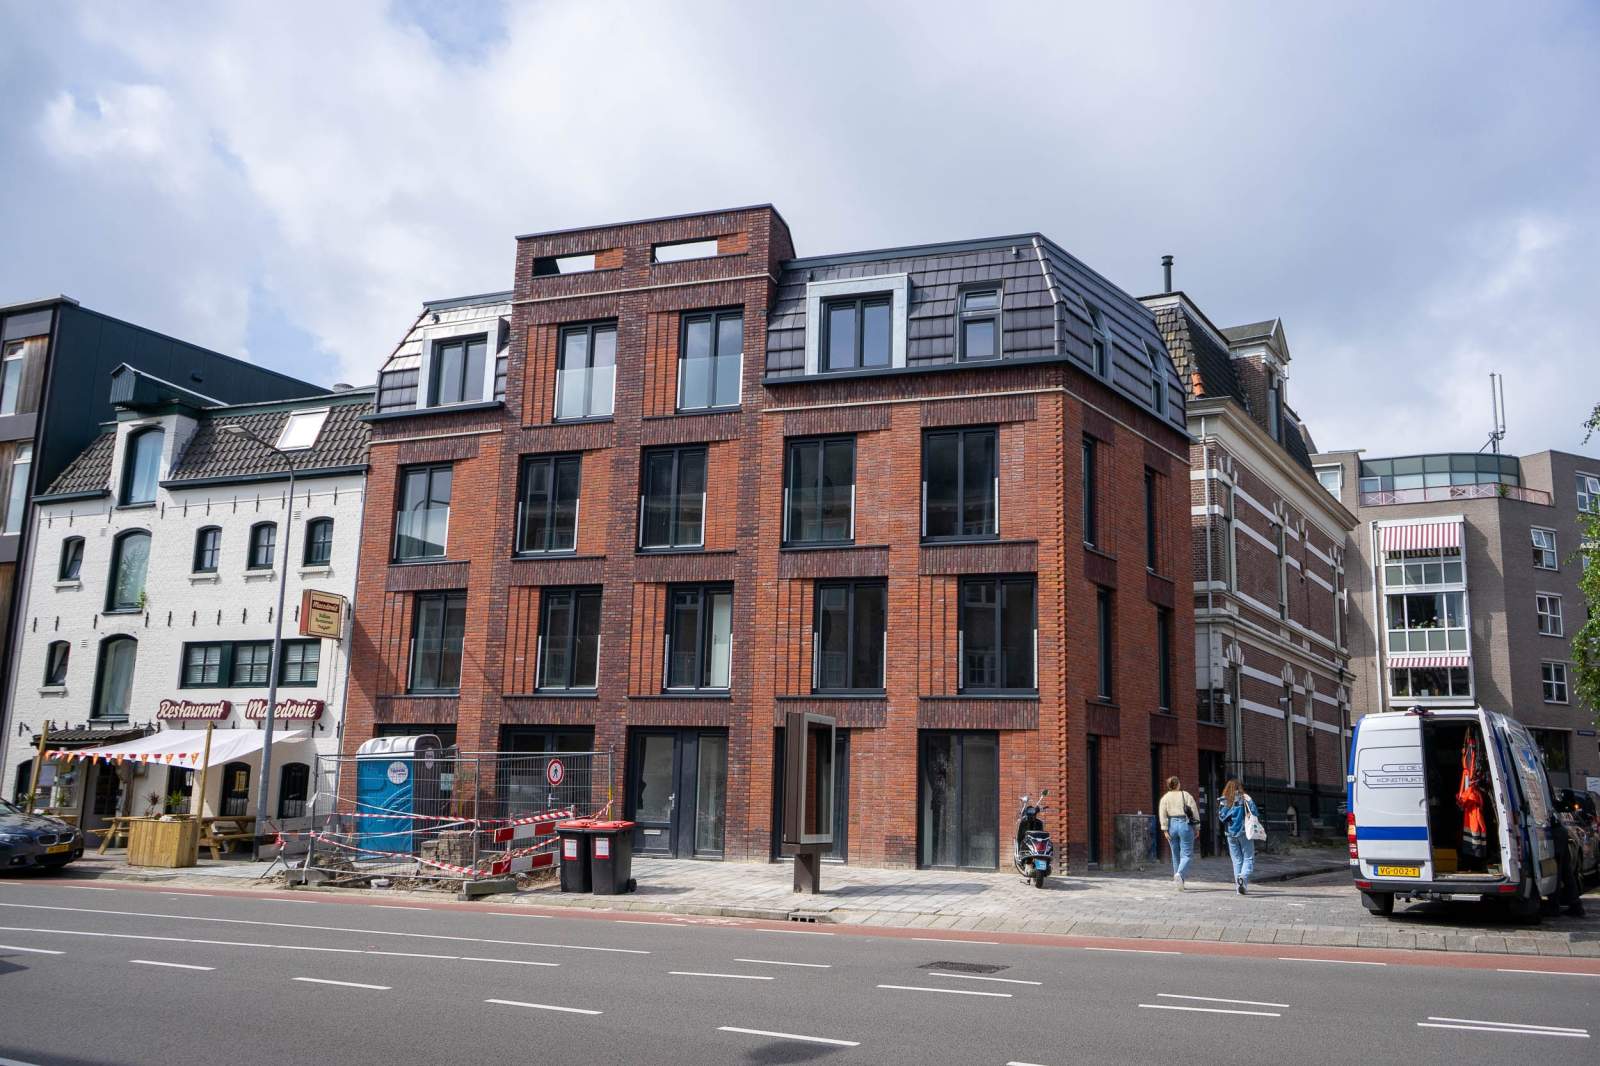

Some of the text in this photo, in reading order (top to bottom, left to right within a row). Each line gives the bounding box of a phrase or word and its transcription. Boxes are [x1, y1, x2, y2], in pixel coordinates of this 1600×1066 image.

[158, 700, 317, 719] Restaurant Maedonië
[1380, 867, 1417, 876] VG-002-T
